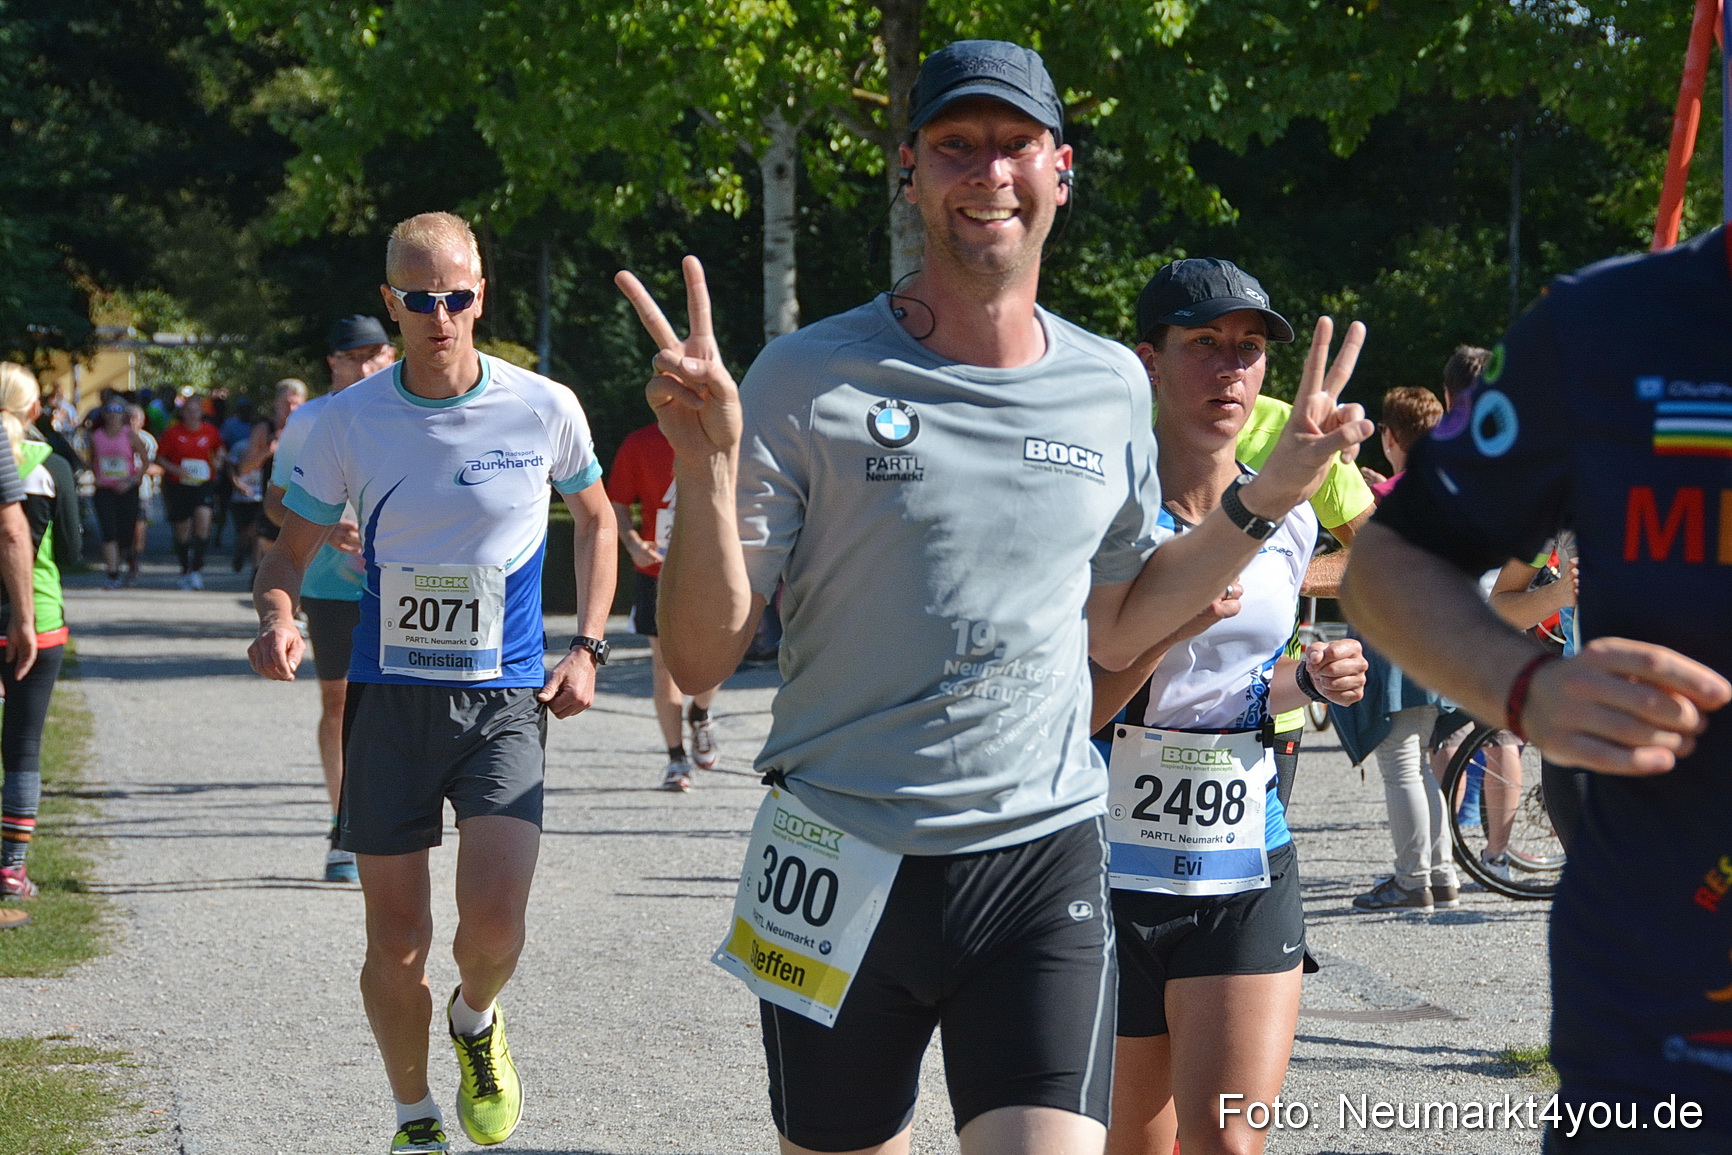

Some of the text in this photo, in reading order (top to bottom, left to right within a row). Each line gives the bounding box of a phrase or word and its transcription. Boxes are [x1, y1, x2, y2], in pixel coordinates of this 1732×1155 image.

[870, 399, 916, 417] BMW
[465, 456, 544, 471] Burkhardt
[866, 457, 924, 470] PARTL
[1023, 437, 1104, 477] BOCK
[866, 472, 923, 481] Neumarkt
[415, 575, 469, 588] BOCK
[399, 596, 479, 632] 2071
[406, 636, 429, 644] PARTL
[951, 619, 1004, 658] 19.
[409, 651, 473, 668] Christian
[1162, 746, 1233, 766] BOCK
[1131, 774, 1247, 827] 2498
[773, 807, 845, 853] BOCK
[1140, 829, 1223, 844] PARTL Neumarkt
[1173, 856, 1203, 875] Evi
[757, 844, 839, 928] 300
[766, 920, 815, 949] Neumarkt
